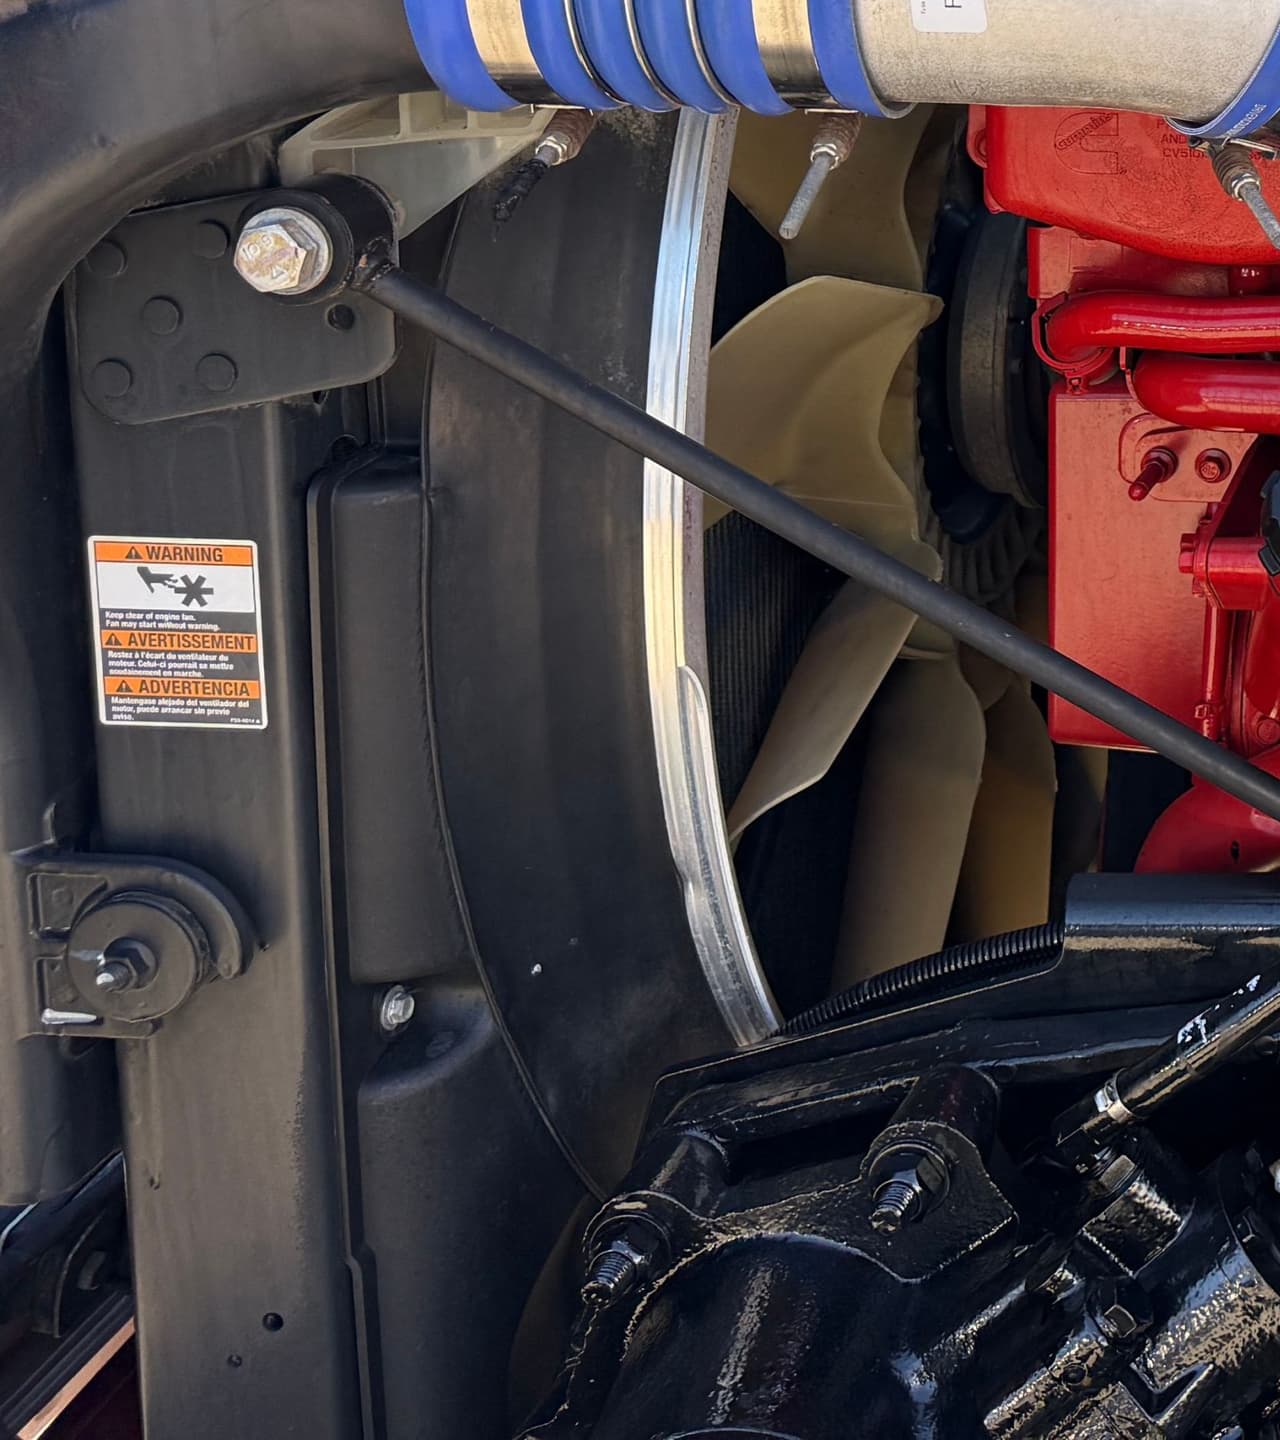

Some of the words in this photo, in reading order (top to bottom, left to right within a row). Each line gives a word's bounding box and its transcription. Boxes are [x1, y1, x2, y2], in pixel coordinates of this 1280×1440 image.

[145, 545, 223, 562] WARNING
[105, 611, 123, 620] Keep
[126, 612, 145, 620] clear
[146, 612, 154, 620] of
[155, 613, 180, 622] engine
[105, 619, 119, 628] Fan
[121, 621, 138, 630] may
[139, 620, 157, 629] start
[158, 621, 187, 630] without
[127, 633, 254, 651] AVERTISSEMENT
[138, 679, 251, 697] ADVERTENCIA
[199, 699, 236, 709] ventilador
[136, 706, 160, 715] puede
[194, 707, 206, 715] sin
